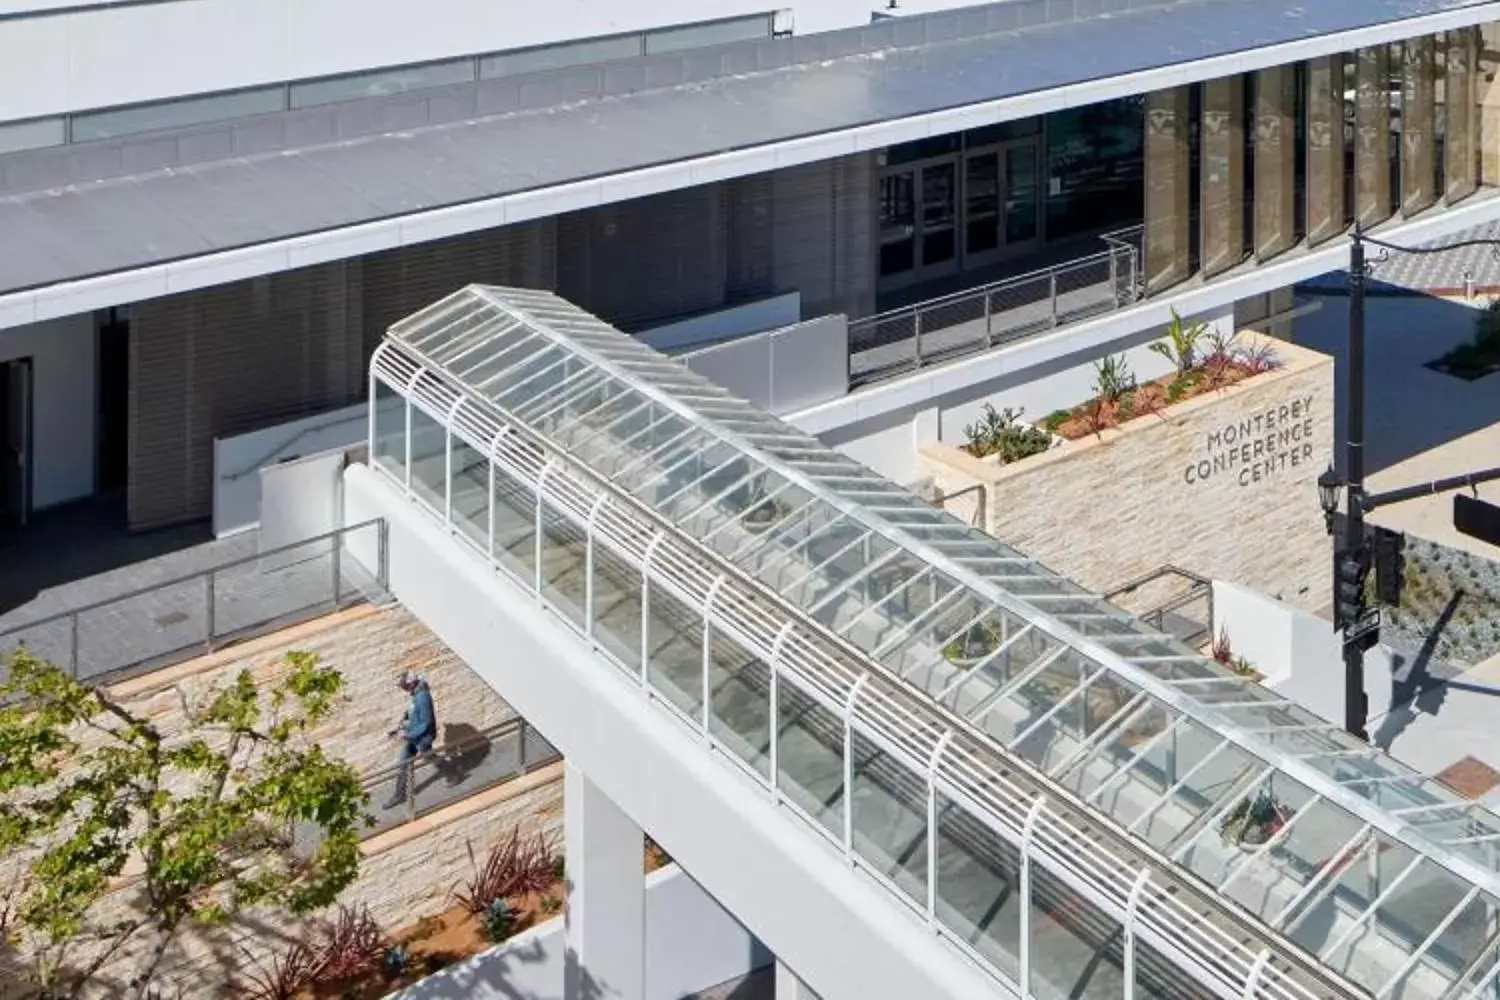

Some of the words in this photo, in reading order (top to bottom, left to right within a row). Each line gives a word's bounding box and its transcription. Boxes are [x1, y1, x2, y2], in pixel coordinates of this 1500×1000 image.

[1185, 419, 1313, 484] CONFERENCE
[1207, 396, 1313, 452] MONTEREY
[1238, 444, 1313, 487] CENTER
